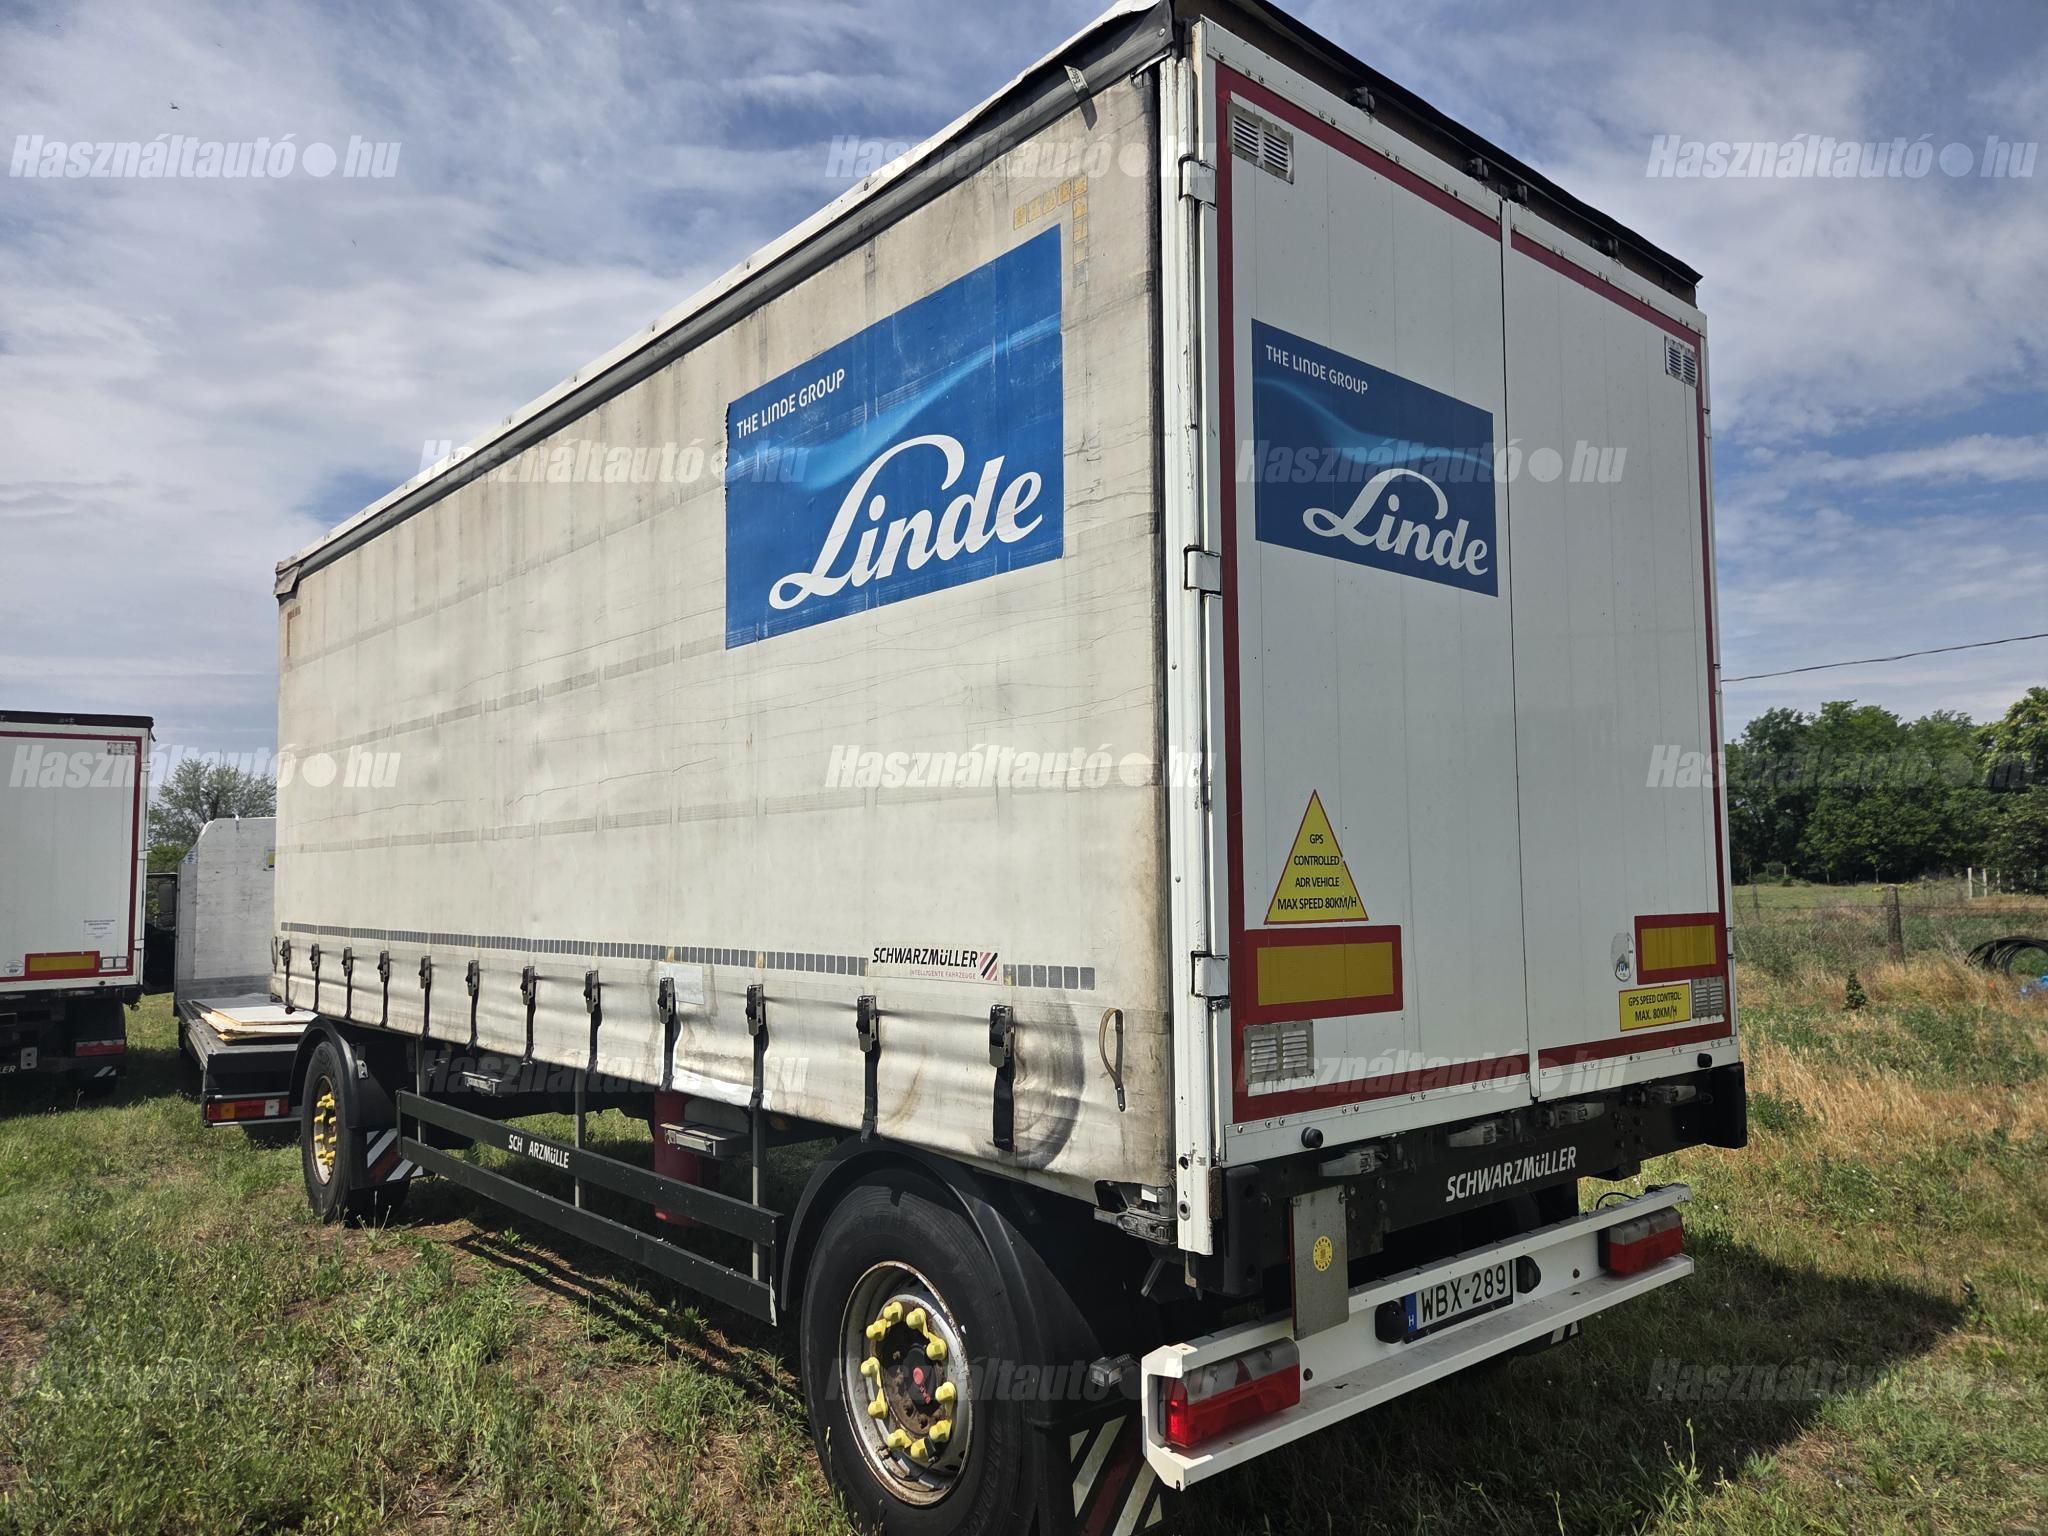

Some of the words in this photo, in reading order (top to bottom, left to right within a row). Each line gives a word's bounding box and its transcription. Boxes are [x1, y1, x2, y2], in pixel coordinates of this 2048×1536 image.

[1266, 345, 1289, 367] THE
[1329, 369, 1368, 395] GROUP
[737, 417, 759, 439] THE
[799, 368, 845, 407] GROUP
[769, 434, 1043, 610] Linde
[1303, 468, 1489, 576] Linde
[1309, 834, 1324, 844] GPS
[1294, 855, 1340, 866] CONTROLLED
[1295, 877, 1311, 888] ADR
[1312, 877, 1340, 888] VEHICLE
[1277, 898, 1298, 910] MAX
[1299, 897, 1324, 910] SPEED
[1325, 896, 1357, 910] 80KM/H
[1628, 996, 1640, 1007] GPS
[1640, 993, 1656, 1005] SPEED
[1635, 1008, 1652, 1022] MAX.
[1652, 1005, 1678, 1019] 80KM/H
[1421, 1264, 1507, 1323] WBX-289
